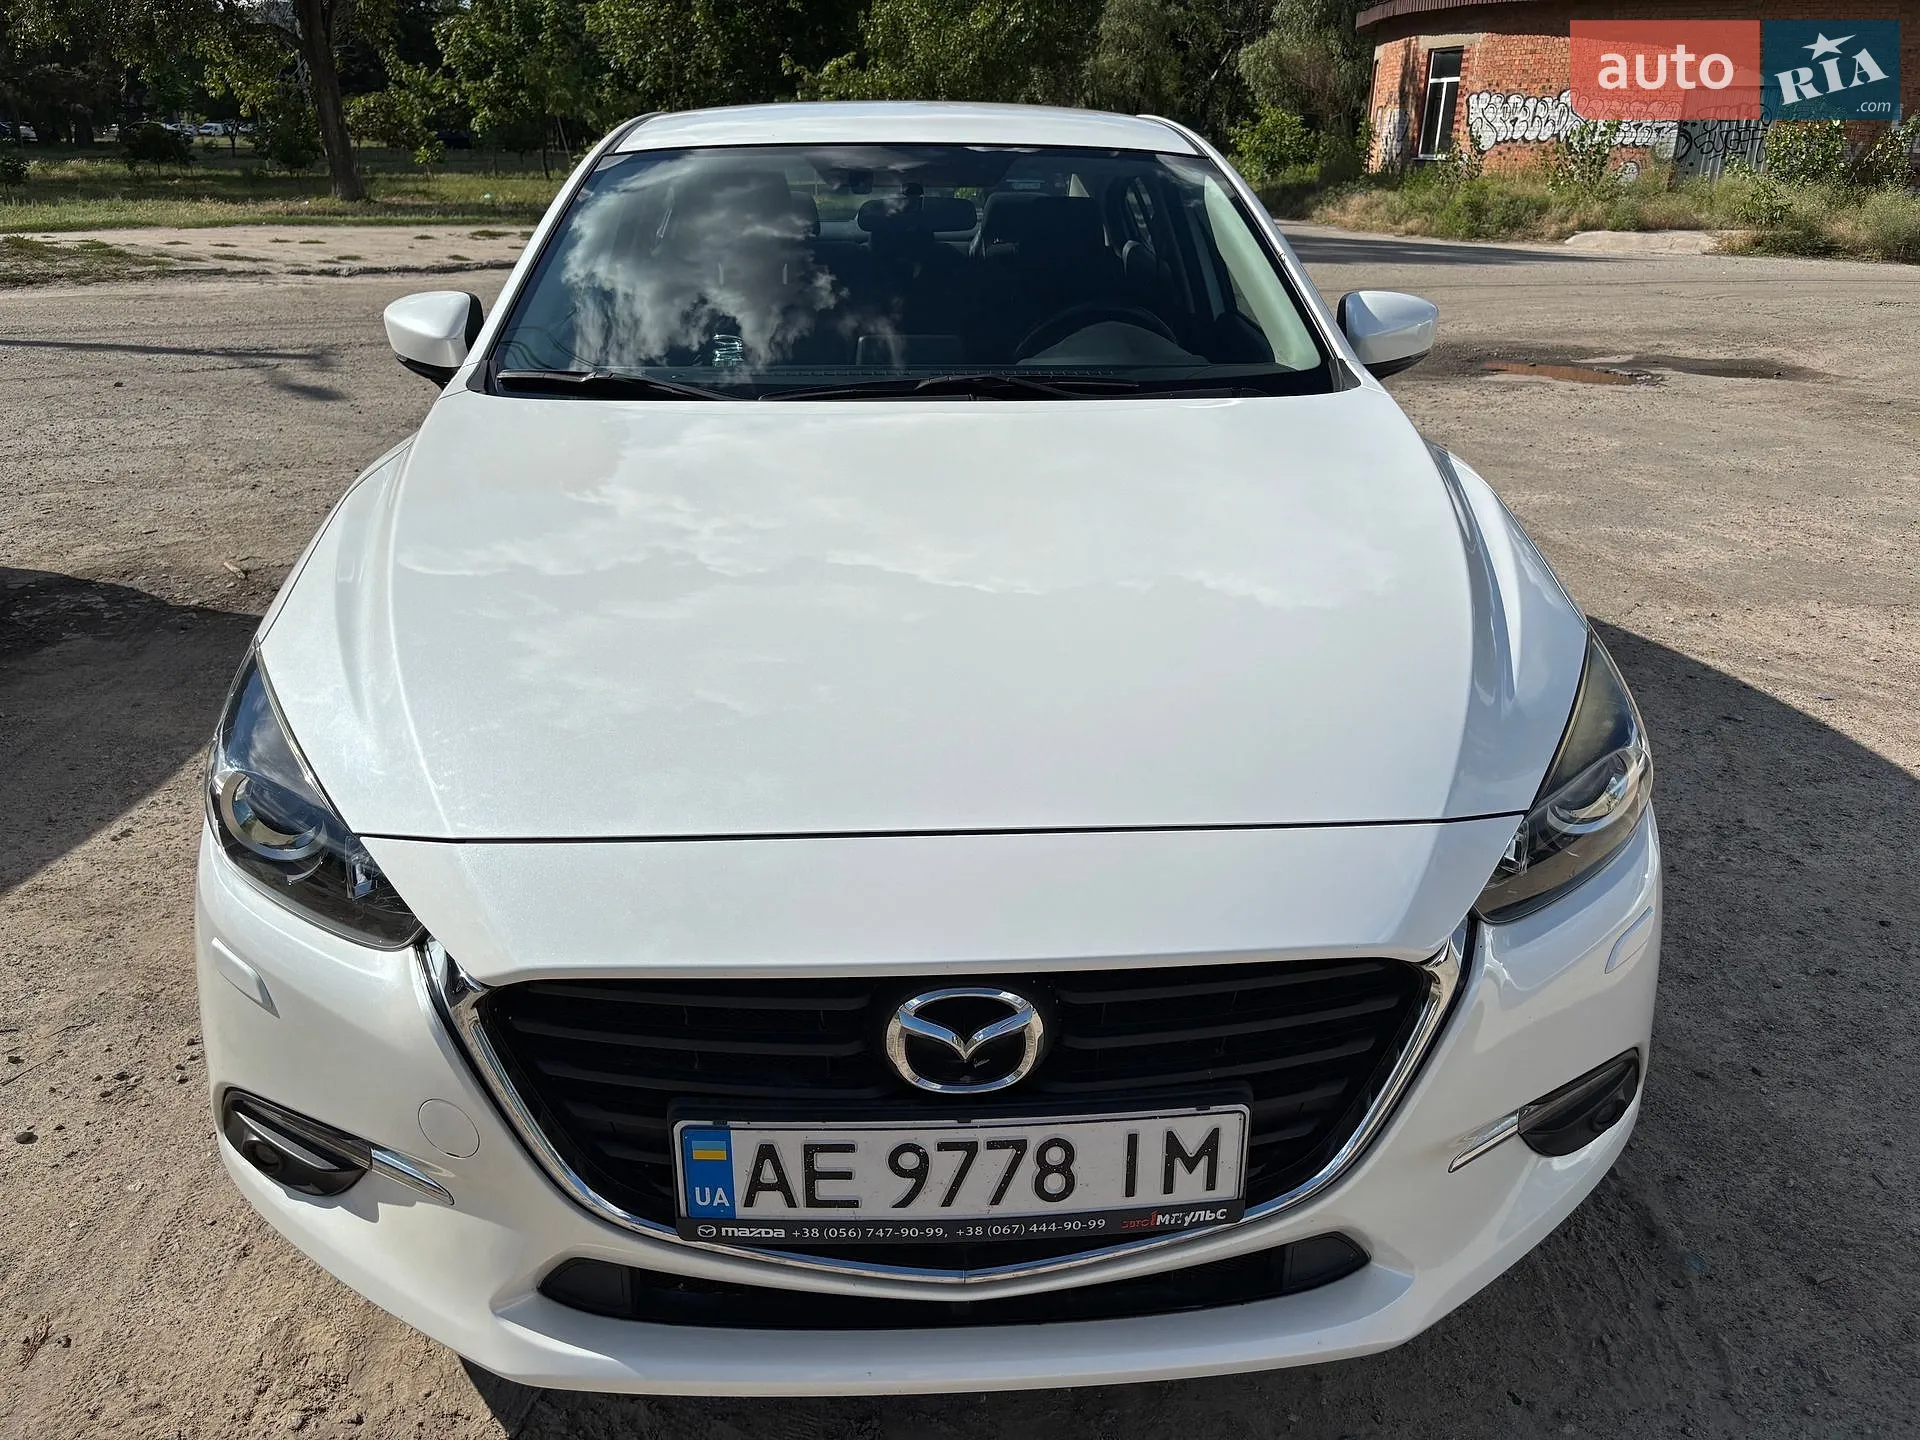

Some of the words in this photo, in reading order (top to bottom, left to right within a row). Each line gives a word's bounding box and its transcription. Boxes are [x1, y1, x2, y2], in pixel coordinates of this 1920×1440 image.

[743, 1143, 860, 1208] AE
[887, 1137, 1076, 1207] 9778
[1124, 1127, 1222, 1197] IM
[695, 1187, 730, 1207] UA
[792, 1228, 820, 1238] +38
[823, 1227, 862, 1239] (056)
[866, 1227, 948, 1238] 747-90-99,
[956, 1226, 983, 1236] +38
[987, 1224, 1025, 1236] (067)
[1029, 1218, 1106, 1233] 444-90-99
